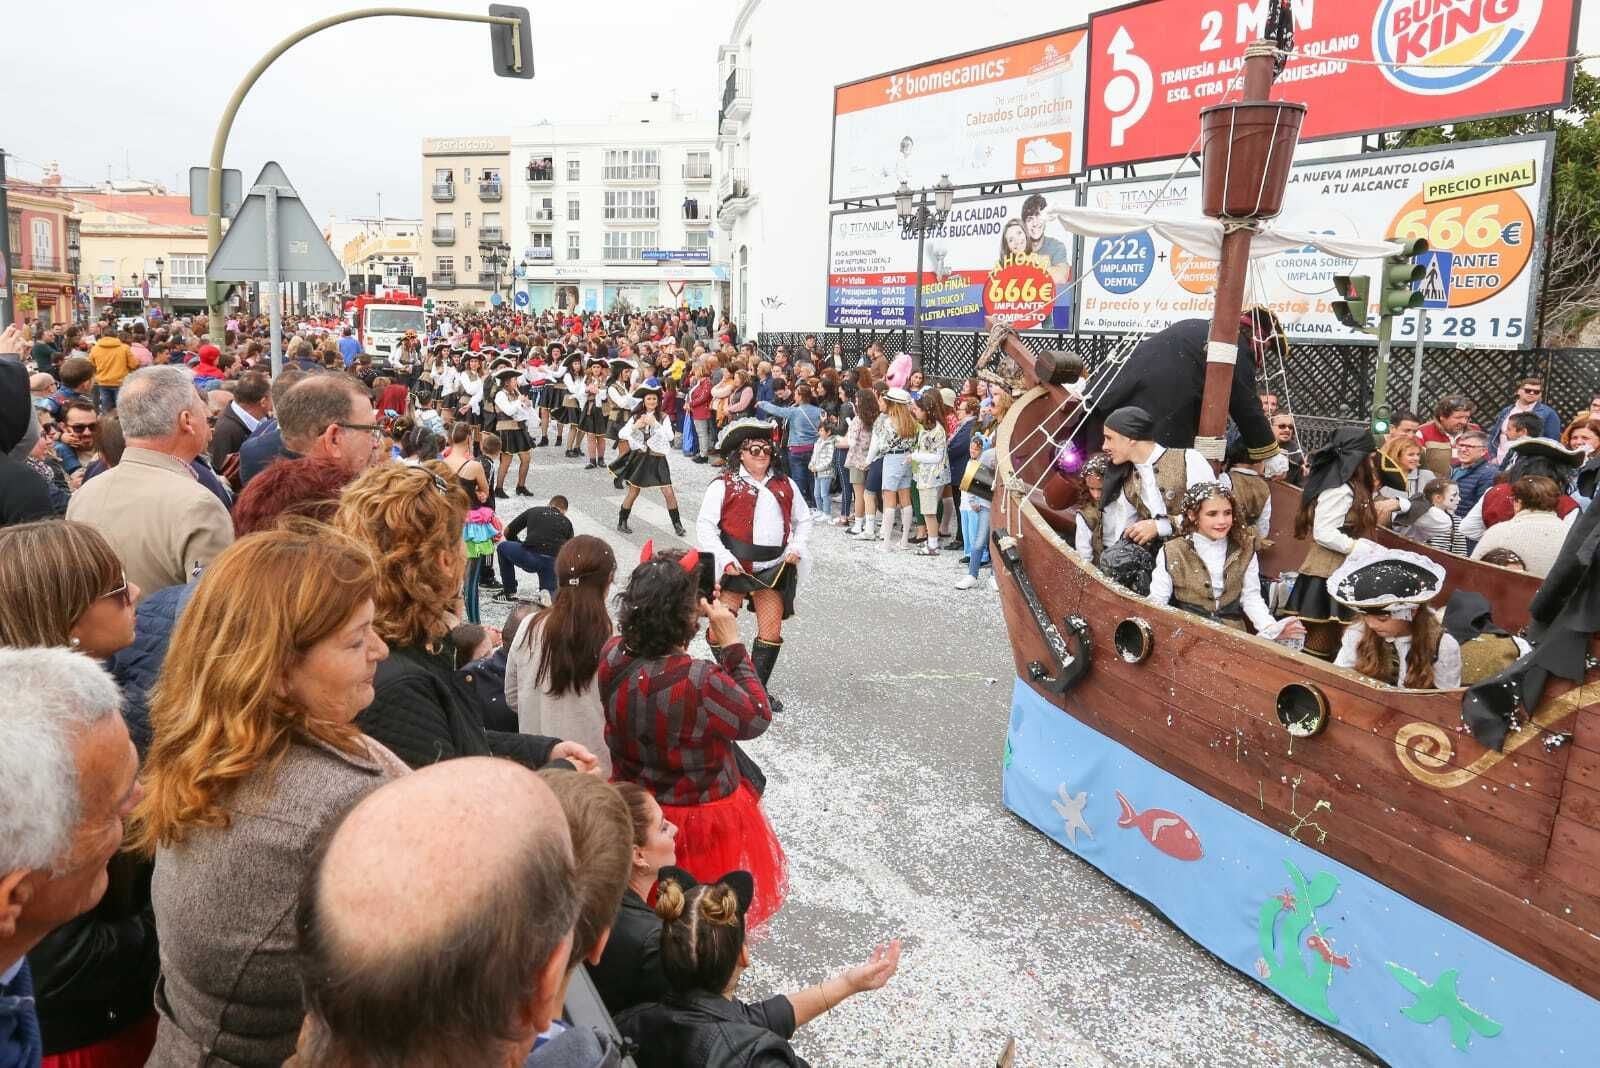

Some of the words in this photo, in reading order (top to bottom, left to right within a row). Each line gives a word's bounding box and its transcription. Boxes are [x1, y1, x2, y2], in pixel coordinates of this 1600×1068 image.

[1200, 11, 1222, 51] 2
[1236, 0, 1314, 44] MN
[1396, 0, 1519, 64] KING
[1161, 61, 1214, 85] TRAVESÍA
[1303, 36, 1359, 57] SOLANO
[906, 60, 1005, 95] biomecanics
[1167, 87, 1191, 103] ESQ.
[1195, 80, 1223, 97] CTRA
[1275, 62, 1347, 84] QUESADO
[966, 108, 1013, 127] Calzados
[1288, 174, 1299, 184] A
[1303, 170, 1342, 183] NUEVA
[1345, 157, 1455, 180] IMPLANTOLOGÍA
[1321, 185, 1331, 194] A
[1335, 183, 1348, 194] TU
[1351, 178, 1410, 192] ALCANCE
[1429, 177, 1481, 197] PRECIO
[1485, 169, 1531, 186] FINAL
[951, 211, 962, 222] LA
[964, 206, 1007, 221] CALIDAD
[950, 222, 1001, 238] BUSCANDO
[1100, 239, 1147, 260] 222€
[1100, 263, 1144, 273] IMPLANTE
[1276, 259, 1317, 268] CORONA
[1320, 257, 1354, 267] SOBRE
[1453, 254, 1499, 267] ANTE
[882, 276, 906, 284] GRATIS
[1104, 277, 1137, 287] DENTAL
[882, 287, 905, 295] GRATIS
[882, 297, 904, 305] GRATIS
[994, 302, 1045, 311] IMPLANTE
[1086, 298, 1097, 309] El
[1099, 298, 1140, 312] precio
[1143, 302, 1151, 313] y
[1172, 297, 1215, 311] calida
[840, 307, 871, 315] Revisiones
[881, 307, 904, 315] GRATIS
[1282, 322, 1333, 334] HICLANA
[1443, 317, 1476, 337] 28
[1490, 317, 1523, 338] 15
